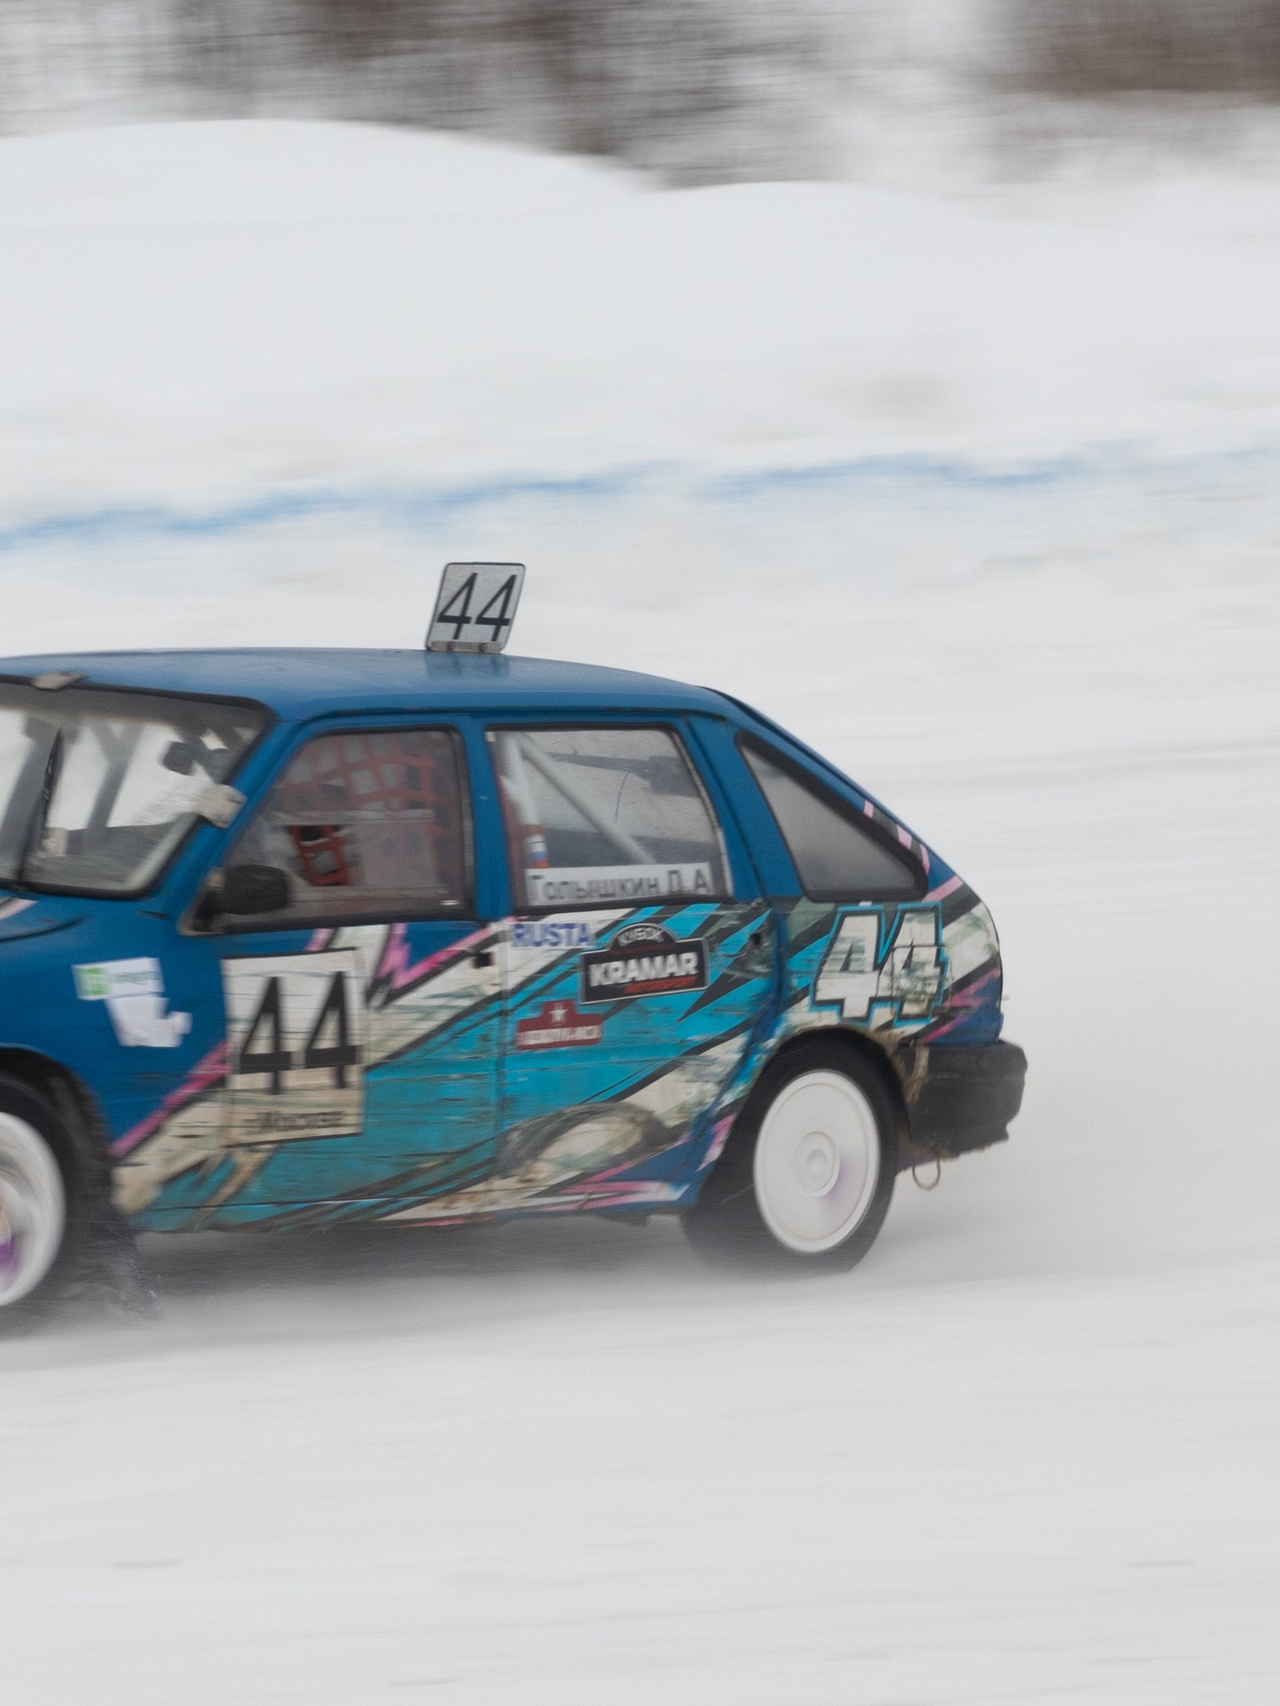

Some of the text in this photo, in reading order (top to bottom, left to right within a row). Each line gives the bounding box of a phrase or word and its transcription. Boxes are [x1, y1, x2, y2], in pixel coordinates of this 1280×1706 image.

[437, 572, 517, 642] 44
[512, 923, 592, 947] RUSTA
[589, 952, 699, 987] KRAMAR
[811, 902, 946, 1025] 44
[239, 971, 363, 1095] 44
